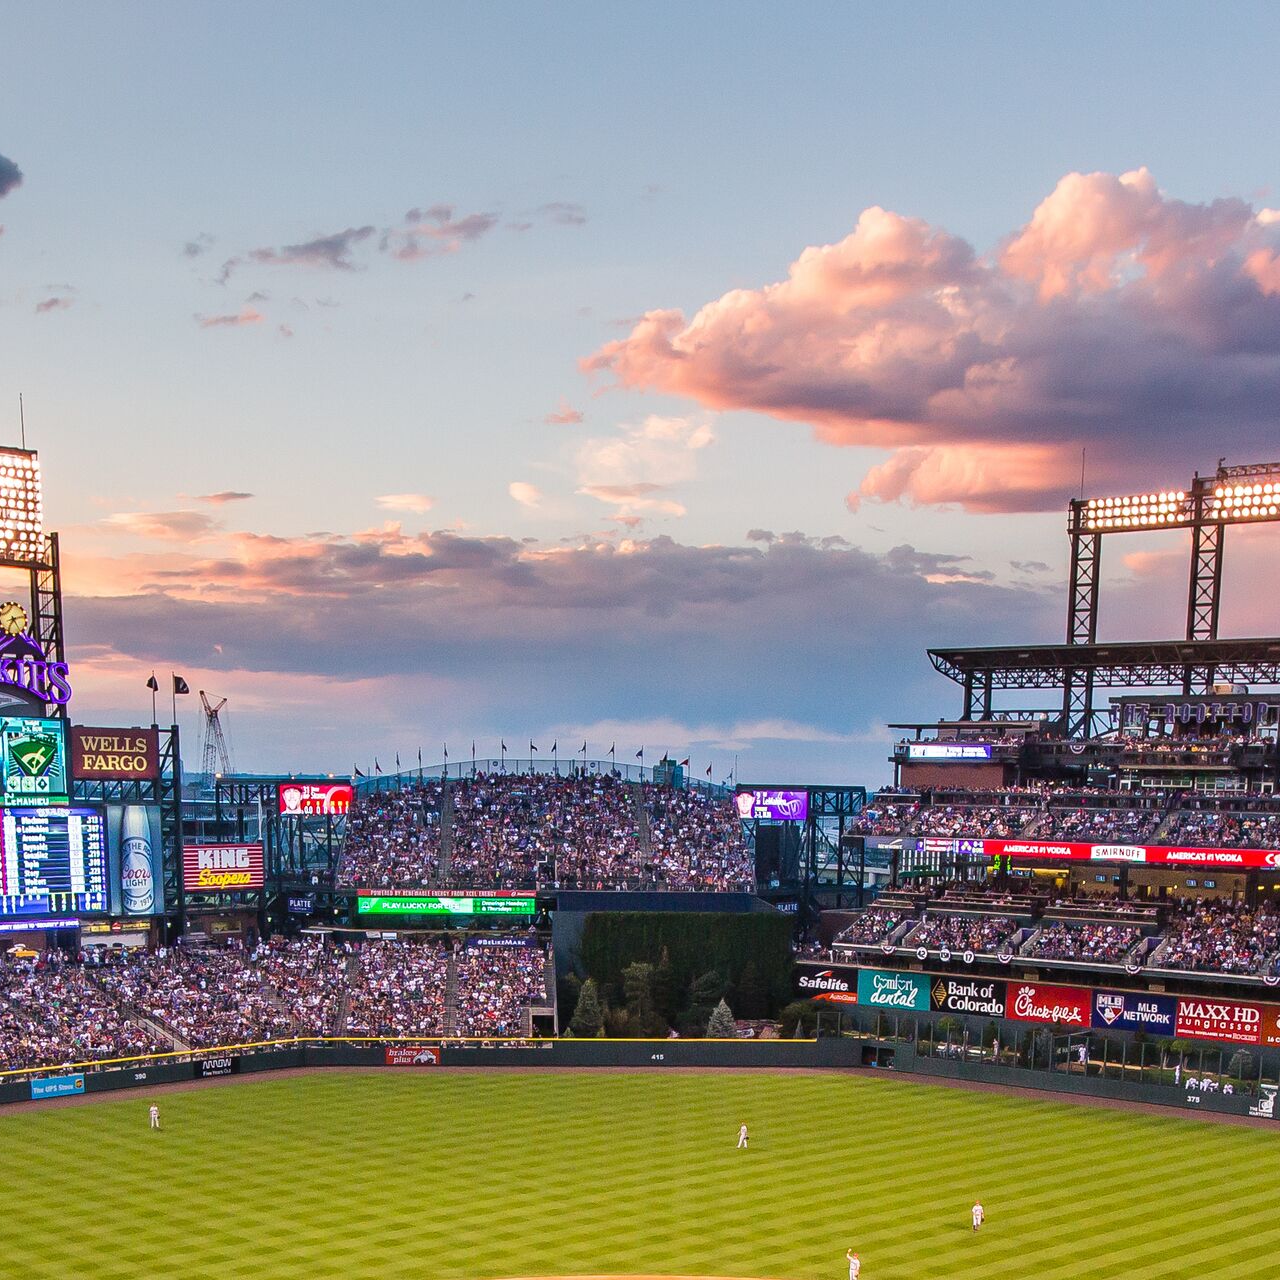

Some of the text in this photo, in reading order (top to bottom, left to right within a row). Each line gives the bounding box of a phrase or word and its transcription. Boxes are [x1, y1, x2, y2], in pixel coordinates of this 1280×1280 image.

[80, 736, 148, 753] WELLS
[82, 754, 148, 771] FARGO
[127, 842, 143, 851] THE
[1003, 844, 1039, 854] AMERICA'S
[1047, 846, 1071, 855] VODKA
[1095, 847, 1142, 859] SMIRNOFF
[1166, 851, 1206, 861] AMERICA'S
[1214, 853, 1242, 863] VODKA
[197, 848, 250, 869] KING
[122, 864, 151, 880] Coors
[197, 868, 252, 889] Soopers
[125, 878, 147, 887] LIGHT
[289, 899, 311, 908] PLATTE
[965, 953, 973, 961] 17
[798, 976, 848, 992] Safelite
[873, 974, 913, 991] Comfort
[948, 981, 994, 998] Bank of
[829, 993, 857, 1002] AutoGlass
[870, 988, 918, 1007] dental
[948, 995, 1004, 1014] Colorado
[1098, 995, 1122, 1006] MLB
[1014, 992, 1082, 1022] Chick-fil-A
[1137, 1002, 1158, 1013] MLB
[1178, 1002, 1260, 1023] MAXX HD
[1123, 1010, 1170, 1024] NETWORK
[1178, 1017, 1258, 1032] sunglasses
[1232, 1032, 1258, 1042] ROCKIES
[388, 1049, 418, 1057] brakes
[393, 1056, 412, 1065] plus
[134, 1073, 147, 1081] 390
[58, 1084, 74, 1092] Store
[1186, 1095, 1200, 1103] 375
